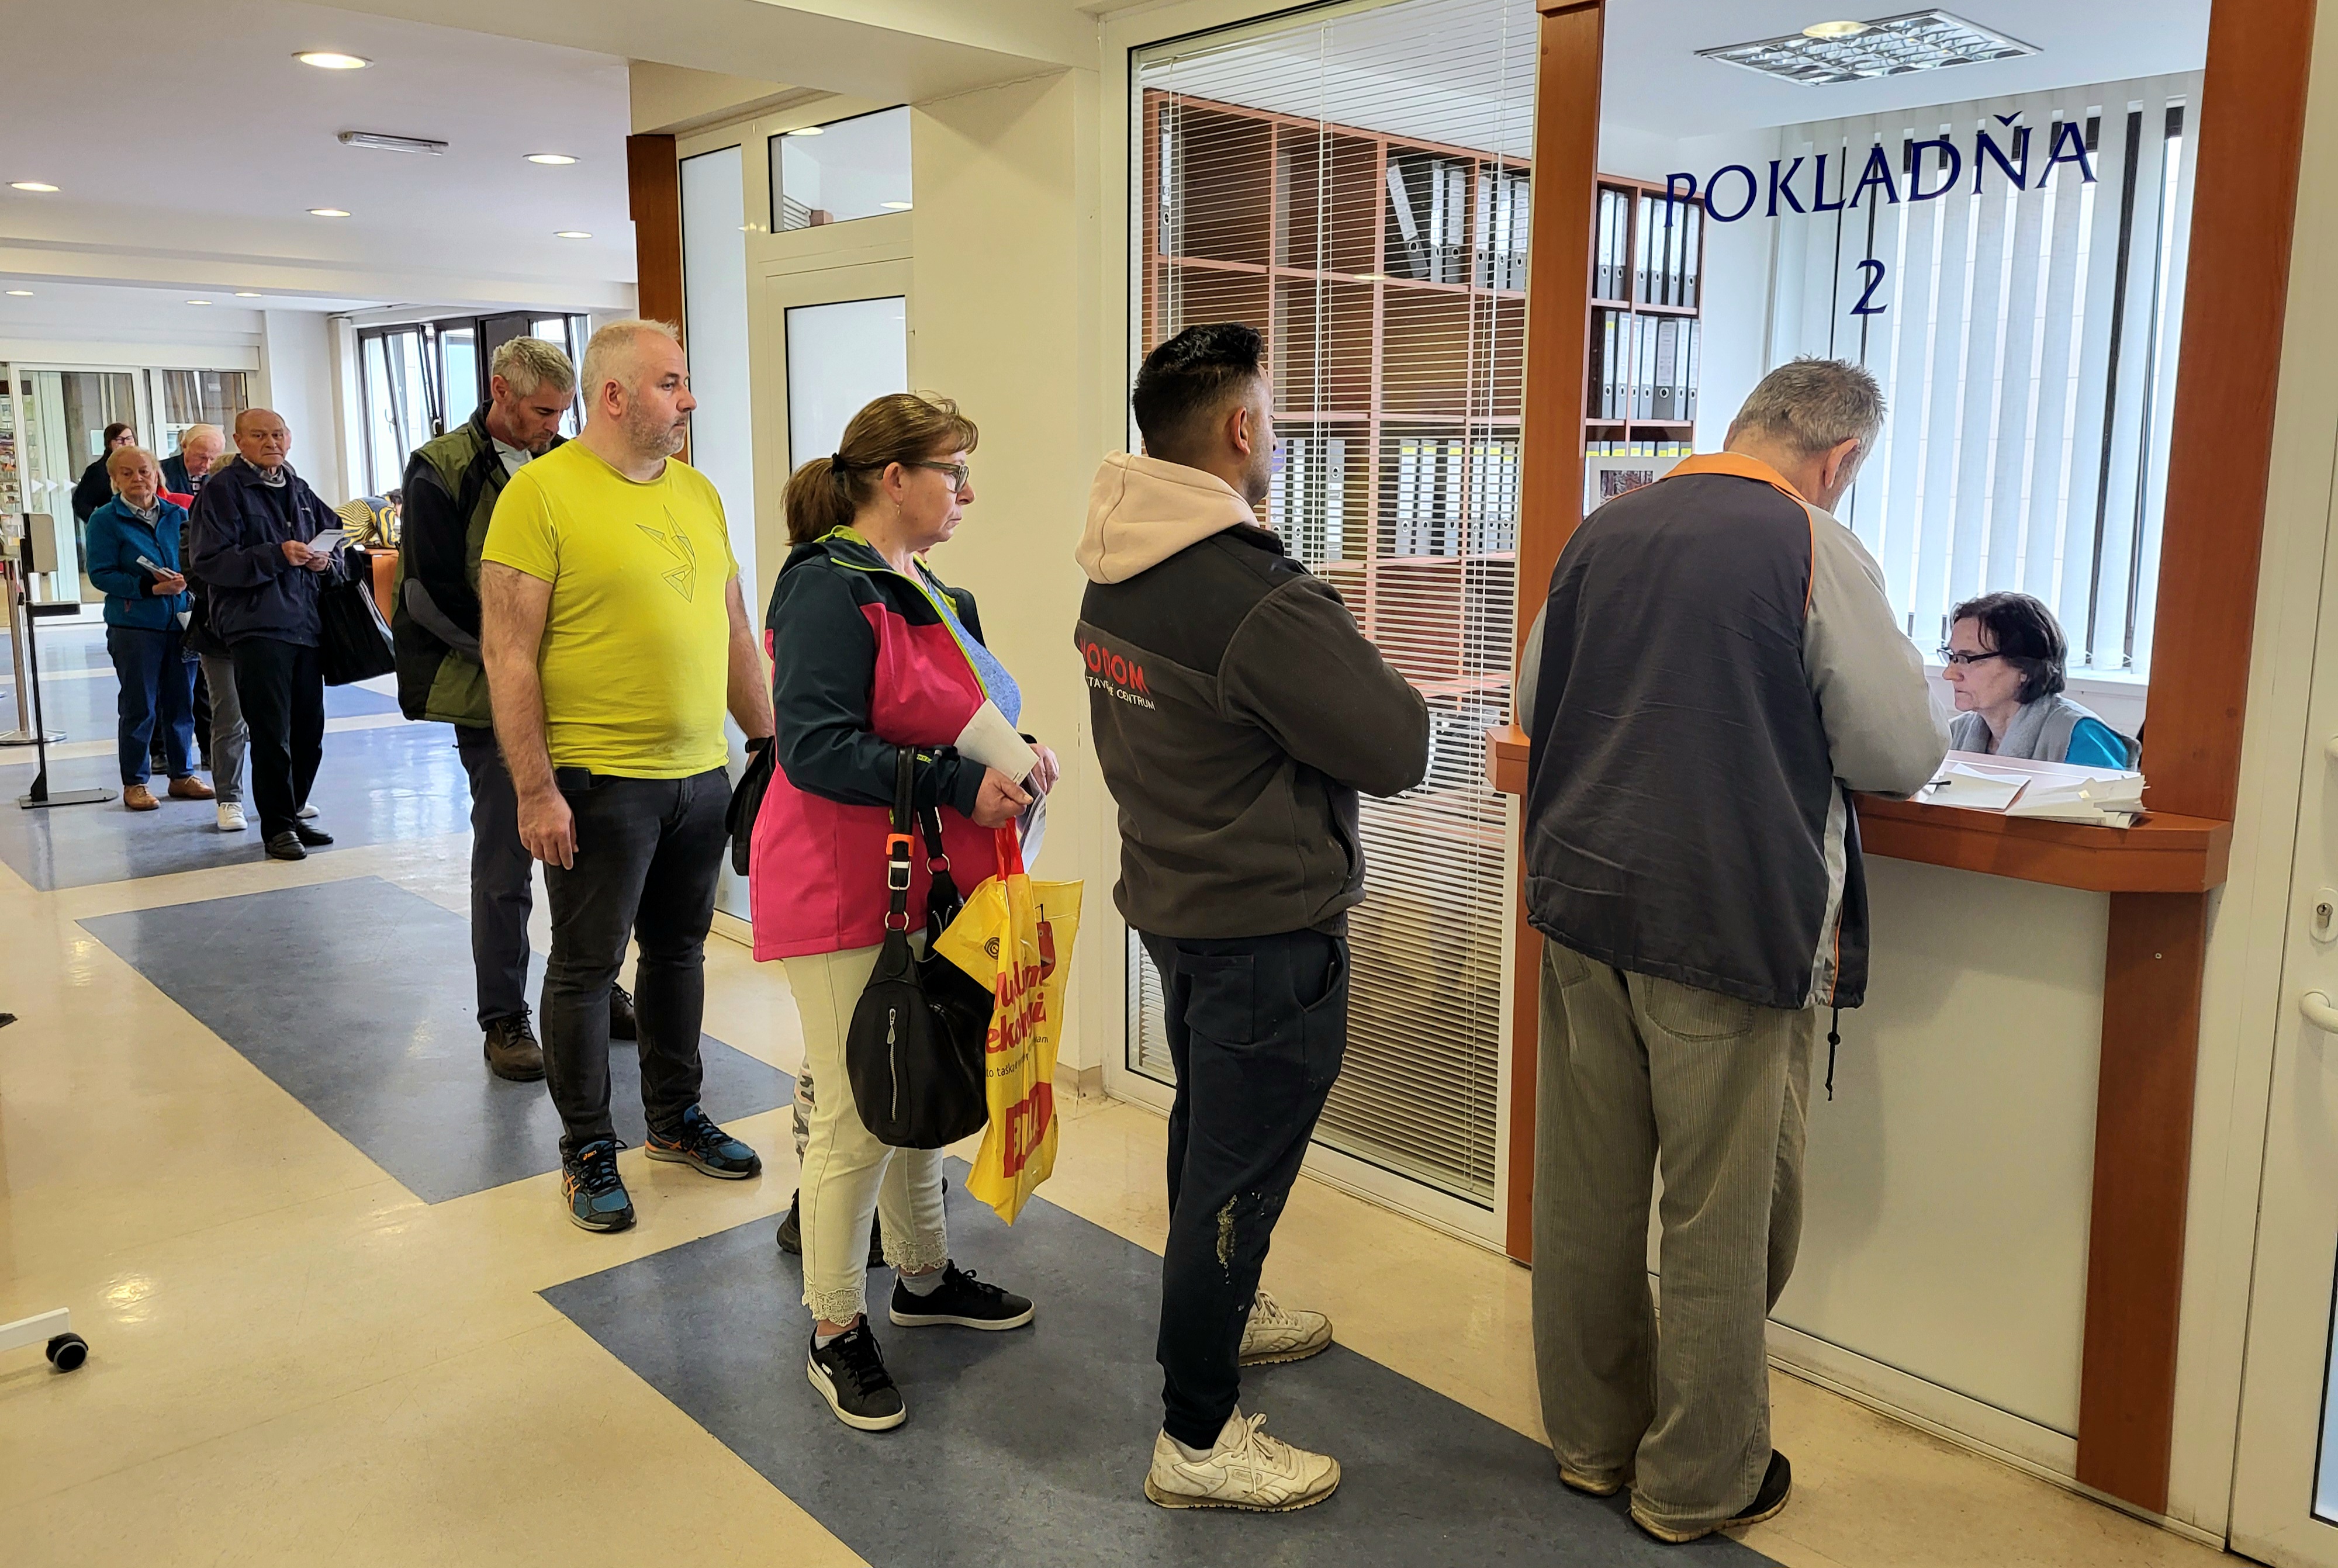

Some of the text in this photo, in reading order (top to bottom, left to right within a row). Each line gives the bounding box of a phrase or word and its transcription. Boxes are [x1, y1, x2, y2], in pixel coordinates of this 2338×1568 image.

[1663, 111, 2098, 228] POKLADŇA
[1849, 259, 1888, 315] 2
[1116, 688, 1156, 711] CENTRUM
